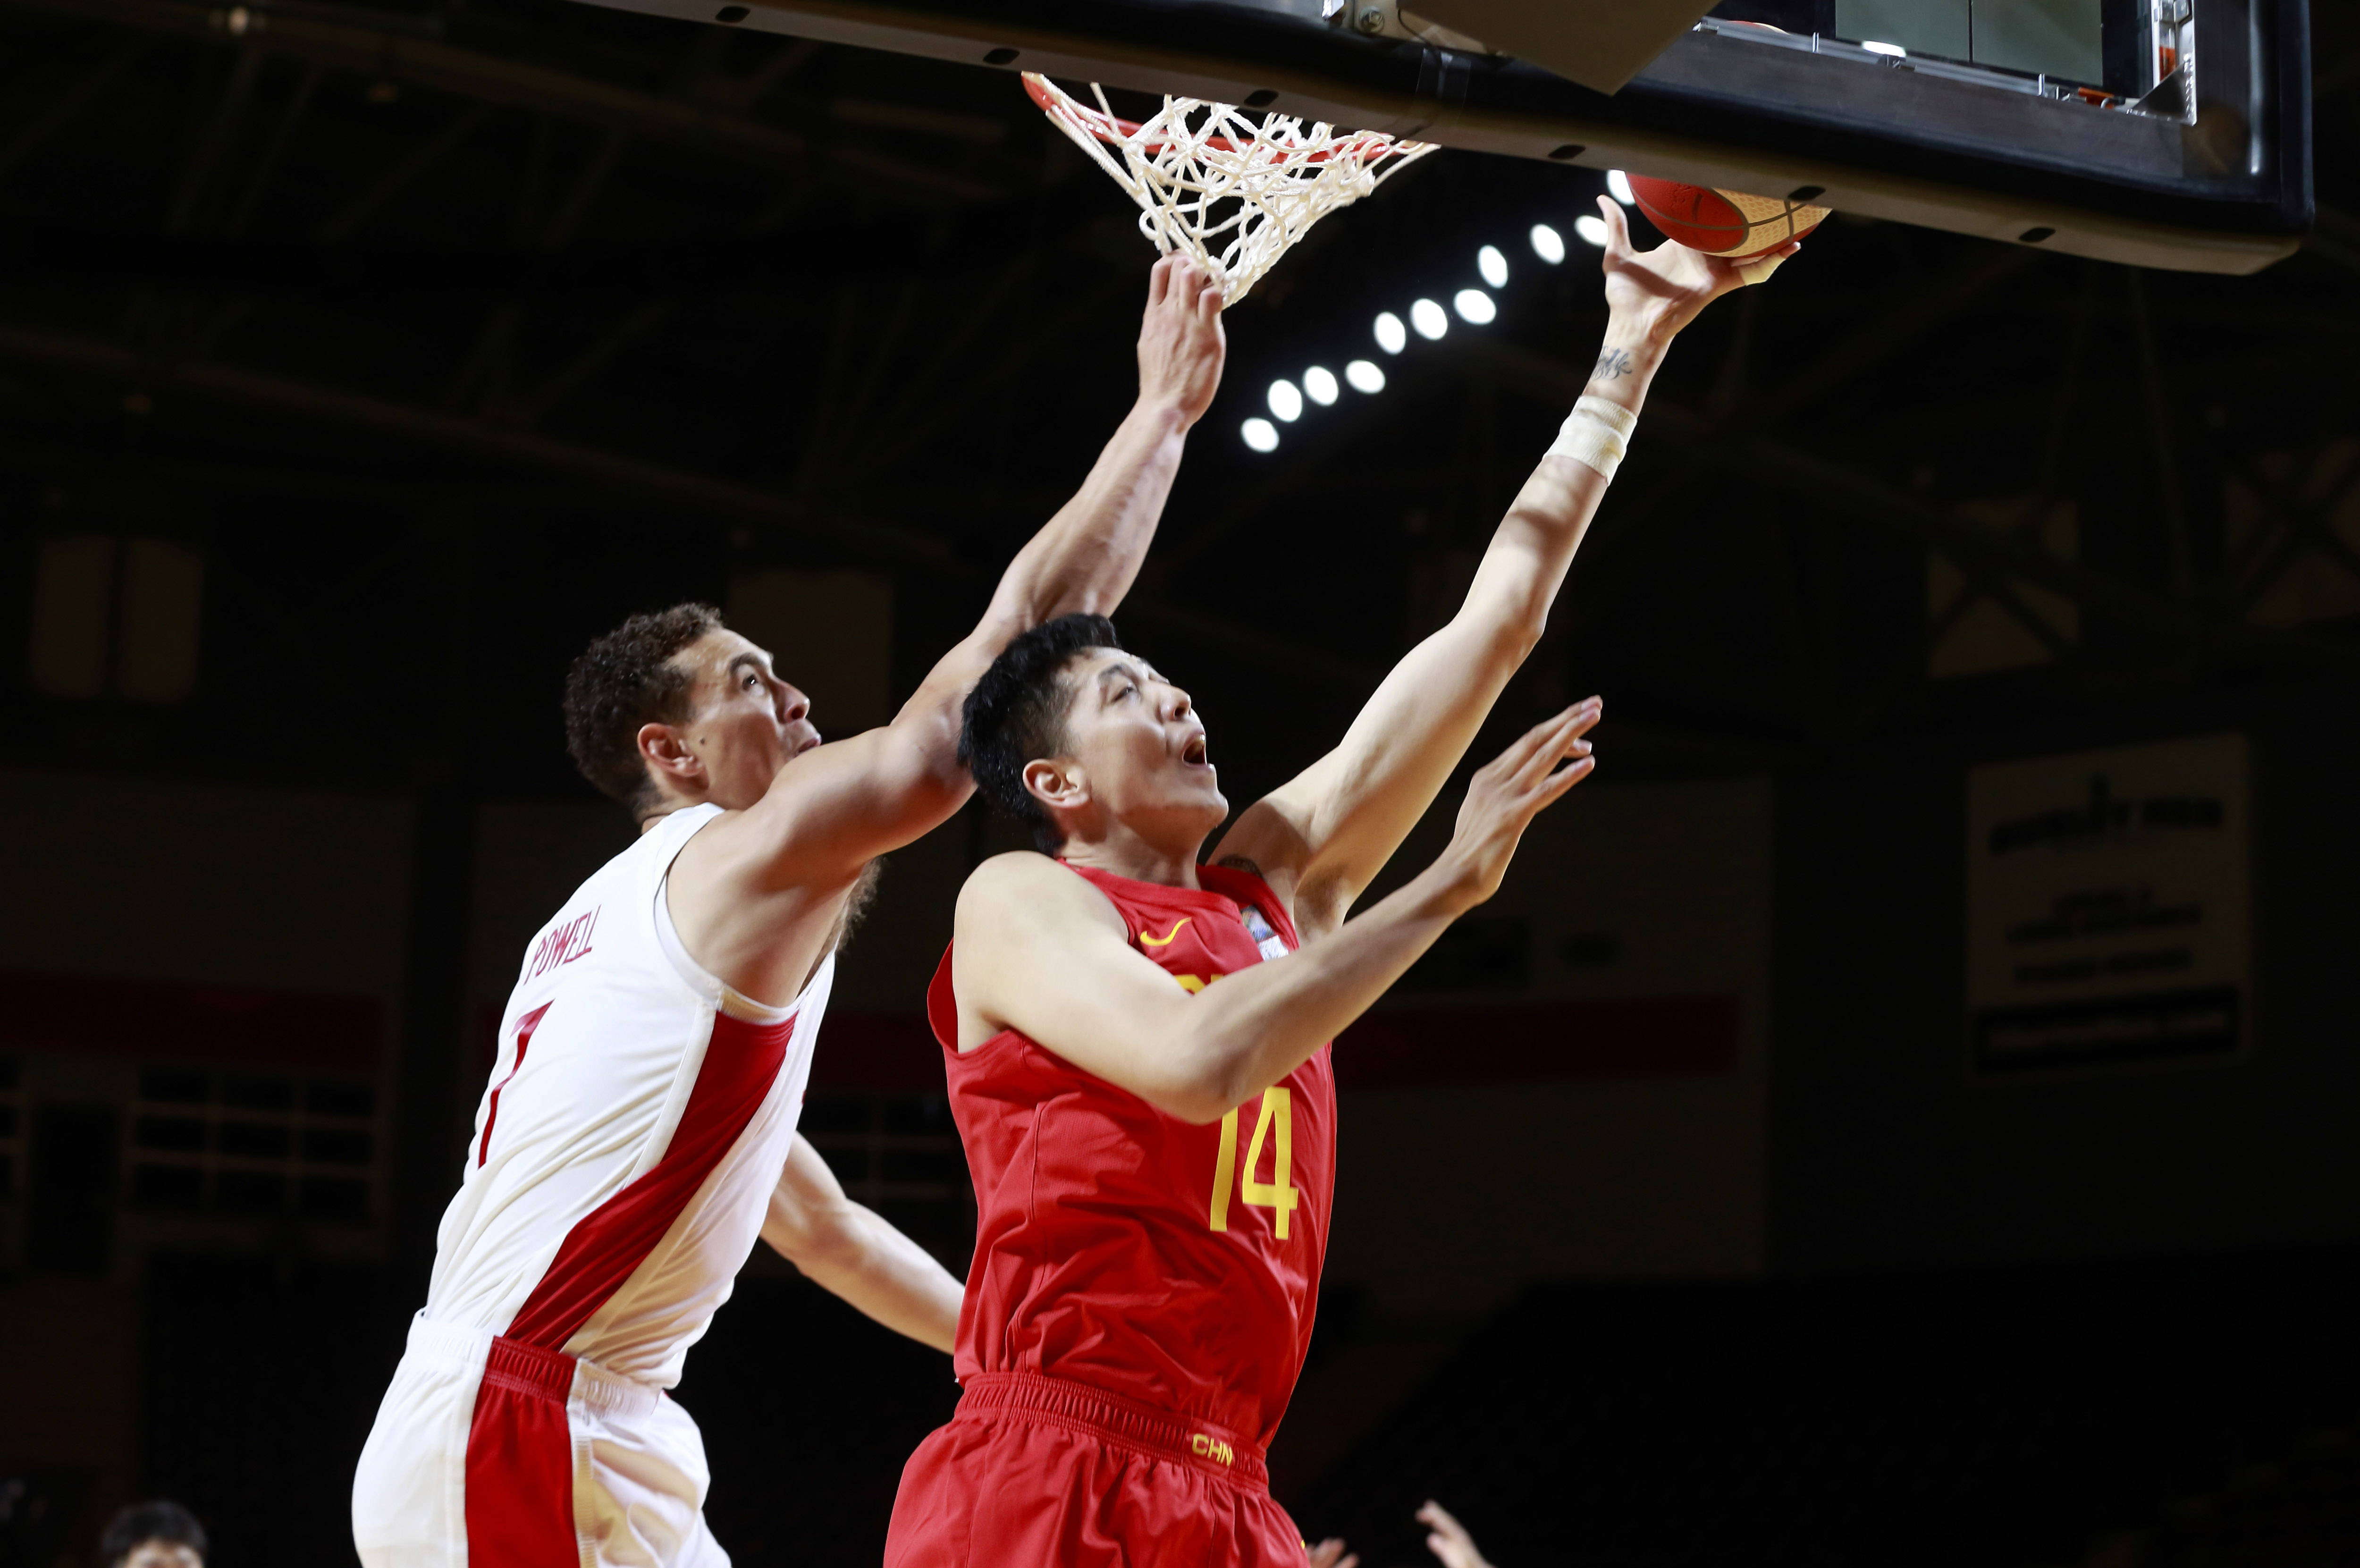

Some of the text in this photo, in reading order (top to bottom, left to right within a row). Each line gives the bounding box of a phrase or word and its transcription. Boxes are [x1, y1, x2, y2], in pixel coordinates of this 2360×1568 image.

[523, 904, 601, 986] POWELL
[478, 997, 556, 1171] 7
[1210, 1085, 1299, 1240] 14
[1192, 1433, 1233, 1466] CHN
